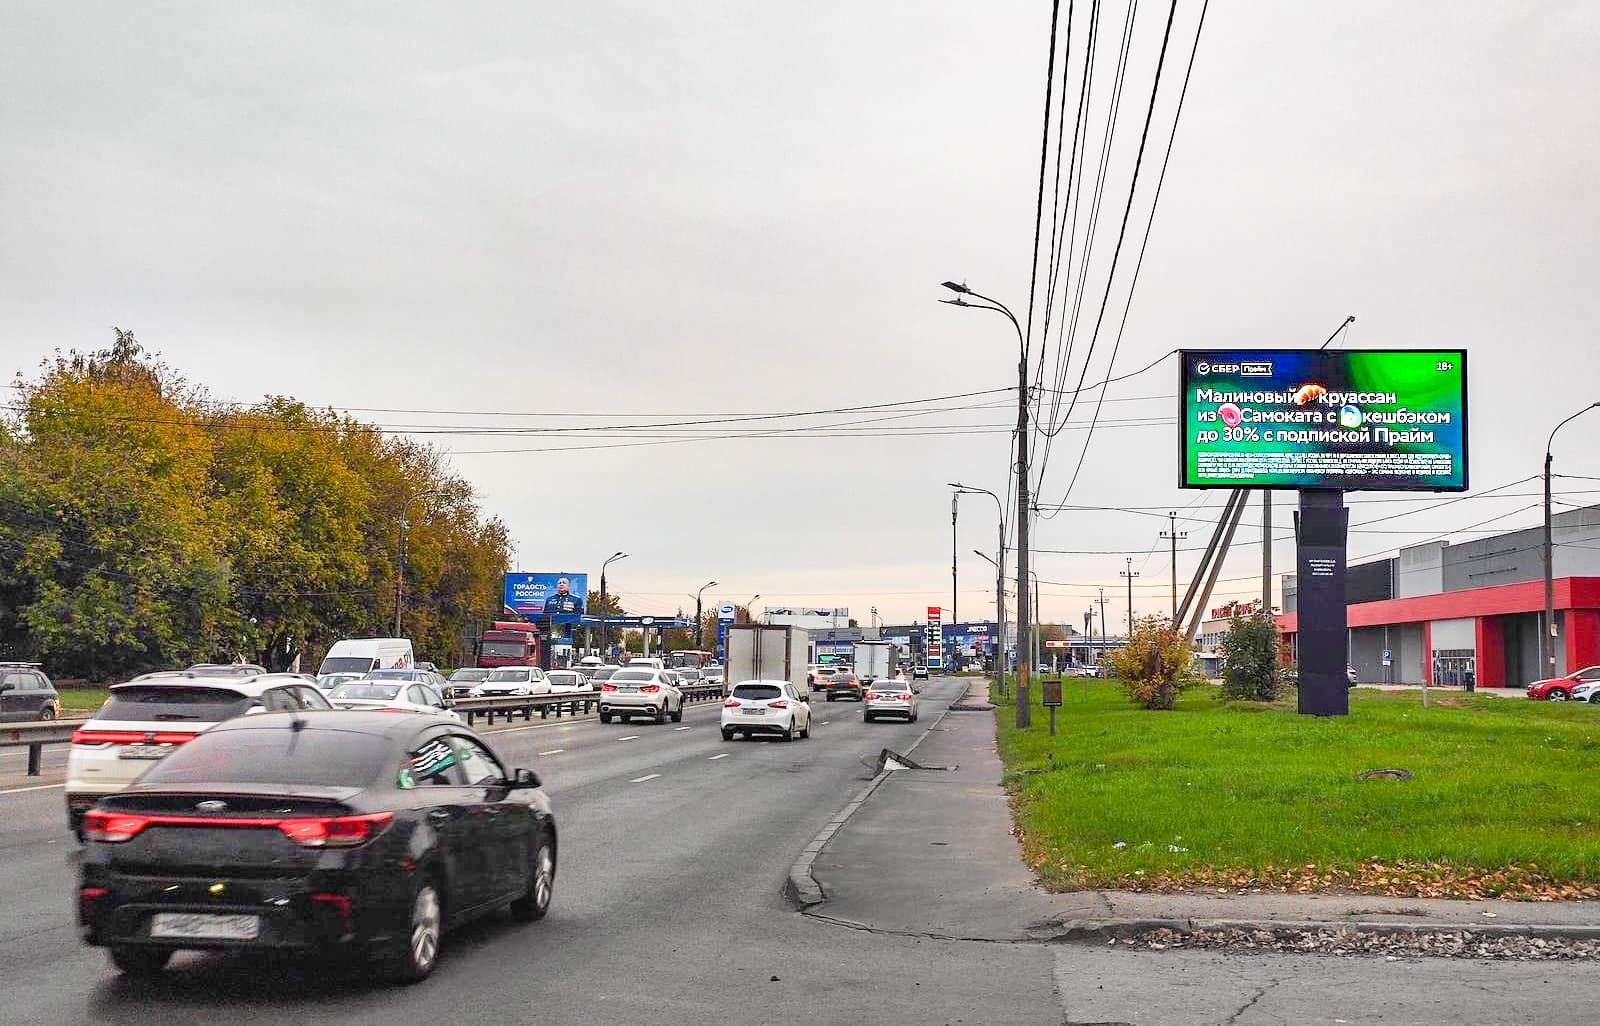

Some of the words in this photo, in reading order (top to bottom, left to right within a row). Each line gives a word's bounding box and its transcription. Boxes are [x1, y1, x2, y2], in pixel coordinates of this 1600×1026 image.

[1211, 364, 1240, 374] СБЕР
[1436, 361, 1453, 371] 18+
[1196, 387, 1298, 404] Малиновый
[1319, 392, 1397, 407] круассан
[1197, 411, 1217, 422] из
[1240, 407, 1323, 423] Самоката
[1326, 412, 1337, 423] с
[1362, 407, 1451, 424] кешбэком
[1196, 430, 1219, 443] до
[1222, 426, 1260, 442] 30%
[1263, 430, 1274, 442] с
[1276, 427, 1371, 444] подпиской
[1374, 427, 1435, 446] Прайм
